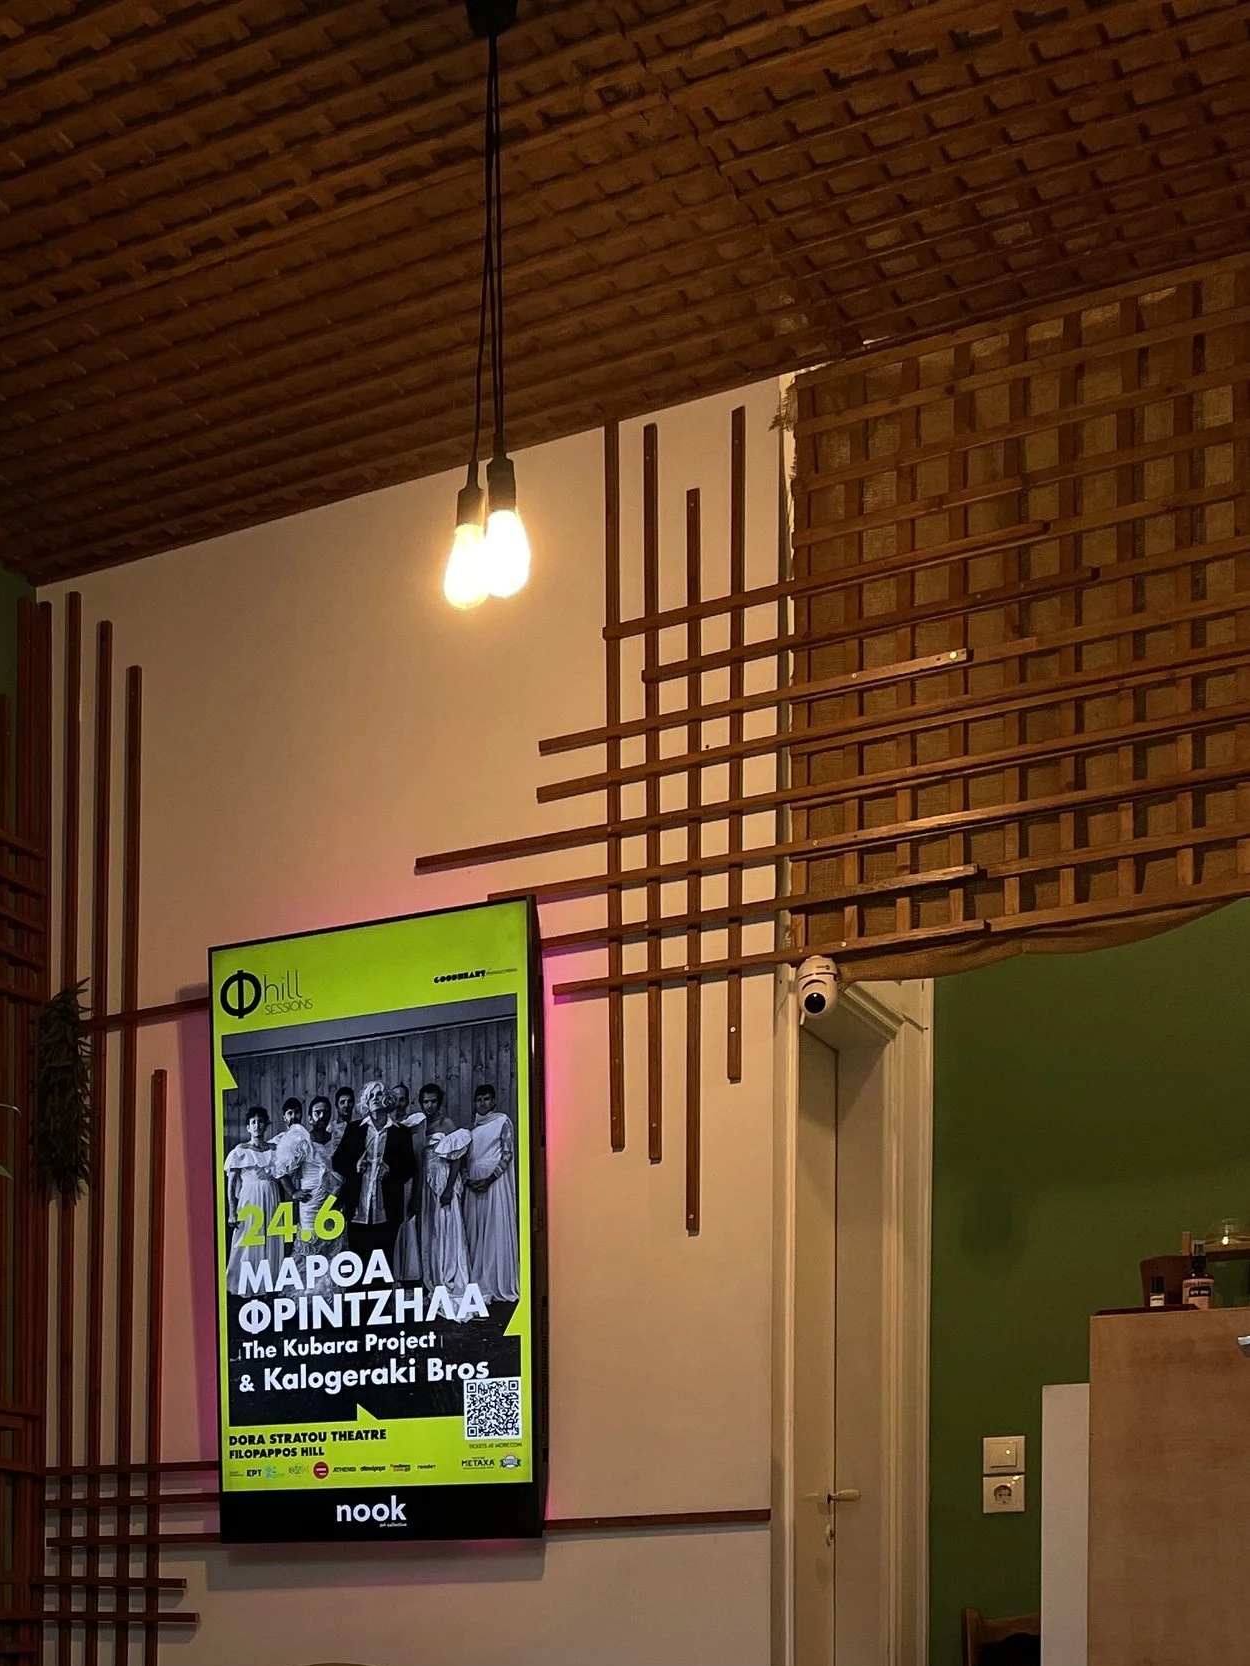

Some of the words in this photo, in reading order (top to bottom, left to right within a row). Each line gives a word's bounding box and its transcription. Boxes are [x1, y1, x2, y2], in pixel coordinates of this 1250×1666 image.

[264, 999, 313, 1015] SESSIONS
[237, 1194, 345, 1247] 24.6
[238, 1249, 394, 1295] ΜΑΡΘΑ
[238, 1282, 490, 1334] ΦΡΙΝΤΖΗΛΑ
[242, 1340, 277, 1360] The
[283, 1336, 358, 1357] Kubara
[365, 1330, 437, 1355] Project
[239, 1374, 255, 1393] &
[264, 1357, 416, 1395] Kalogeraki
[427, 1357, 490, 1382] Bros
[229, 1434, 266, 1446] DORA
[269, 1431, 327, 1444] STRATOU
[331, 1429, 387, 1442] THEATRE
[229, 1447, 298, 1459] FILOPAPPOS
[301, 1446, 325, 1456] HILL
[461, 1459, 495, 1467] METAXA
[336, 1495, 407, 1522] nook
